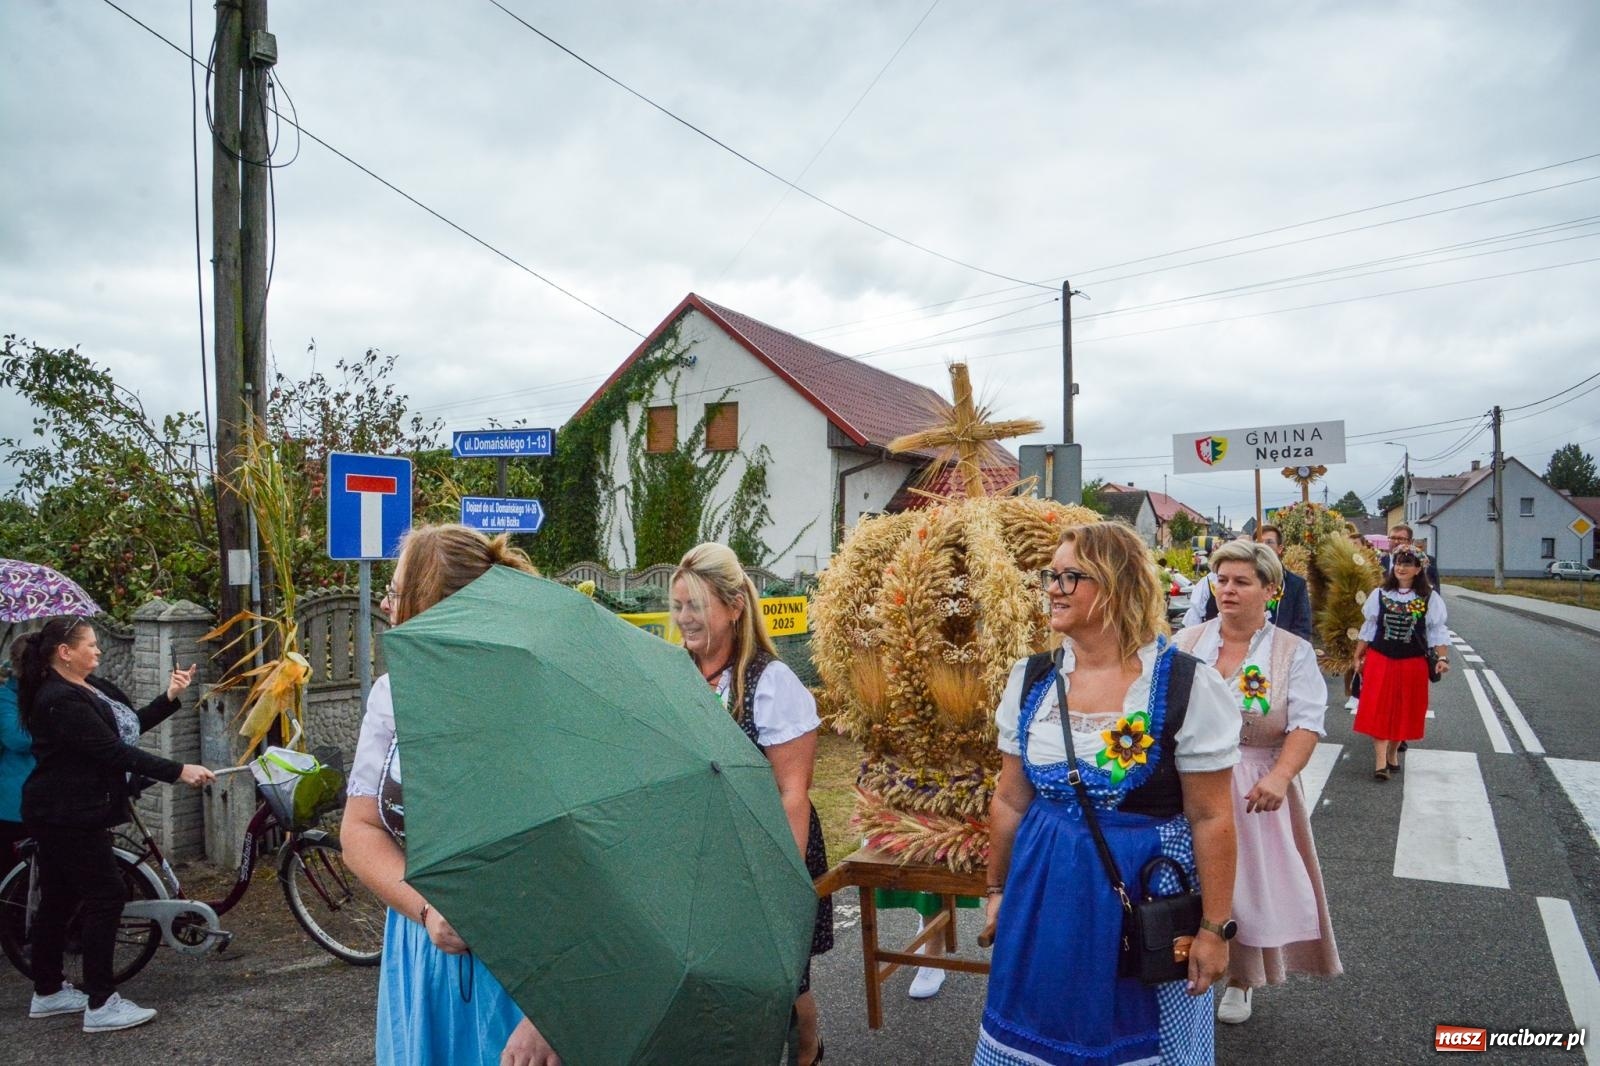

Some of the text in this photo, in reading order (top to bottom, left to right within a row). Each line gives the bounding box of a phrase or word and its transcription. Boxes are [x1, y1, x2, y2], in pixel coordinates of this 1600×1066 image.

[1245, 427, 1323, 445] GMINA
[1255, 445, 1314, 462] Nędza
[466, 501, 482, 515] Dojazd
[482, 502, 489, 512] do
[481, 516, 488, 527] od
[762, 601, 803, 616] DOŻYNKI
[772, 617, 795, 630] 2025
